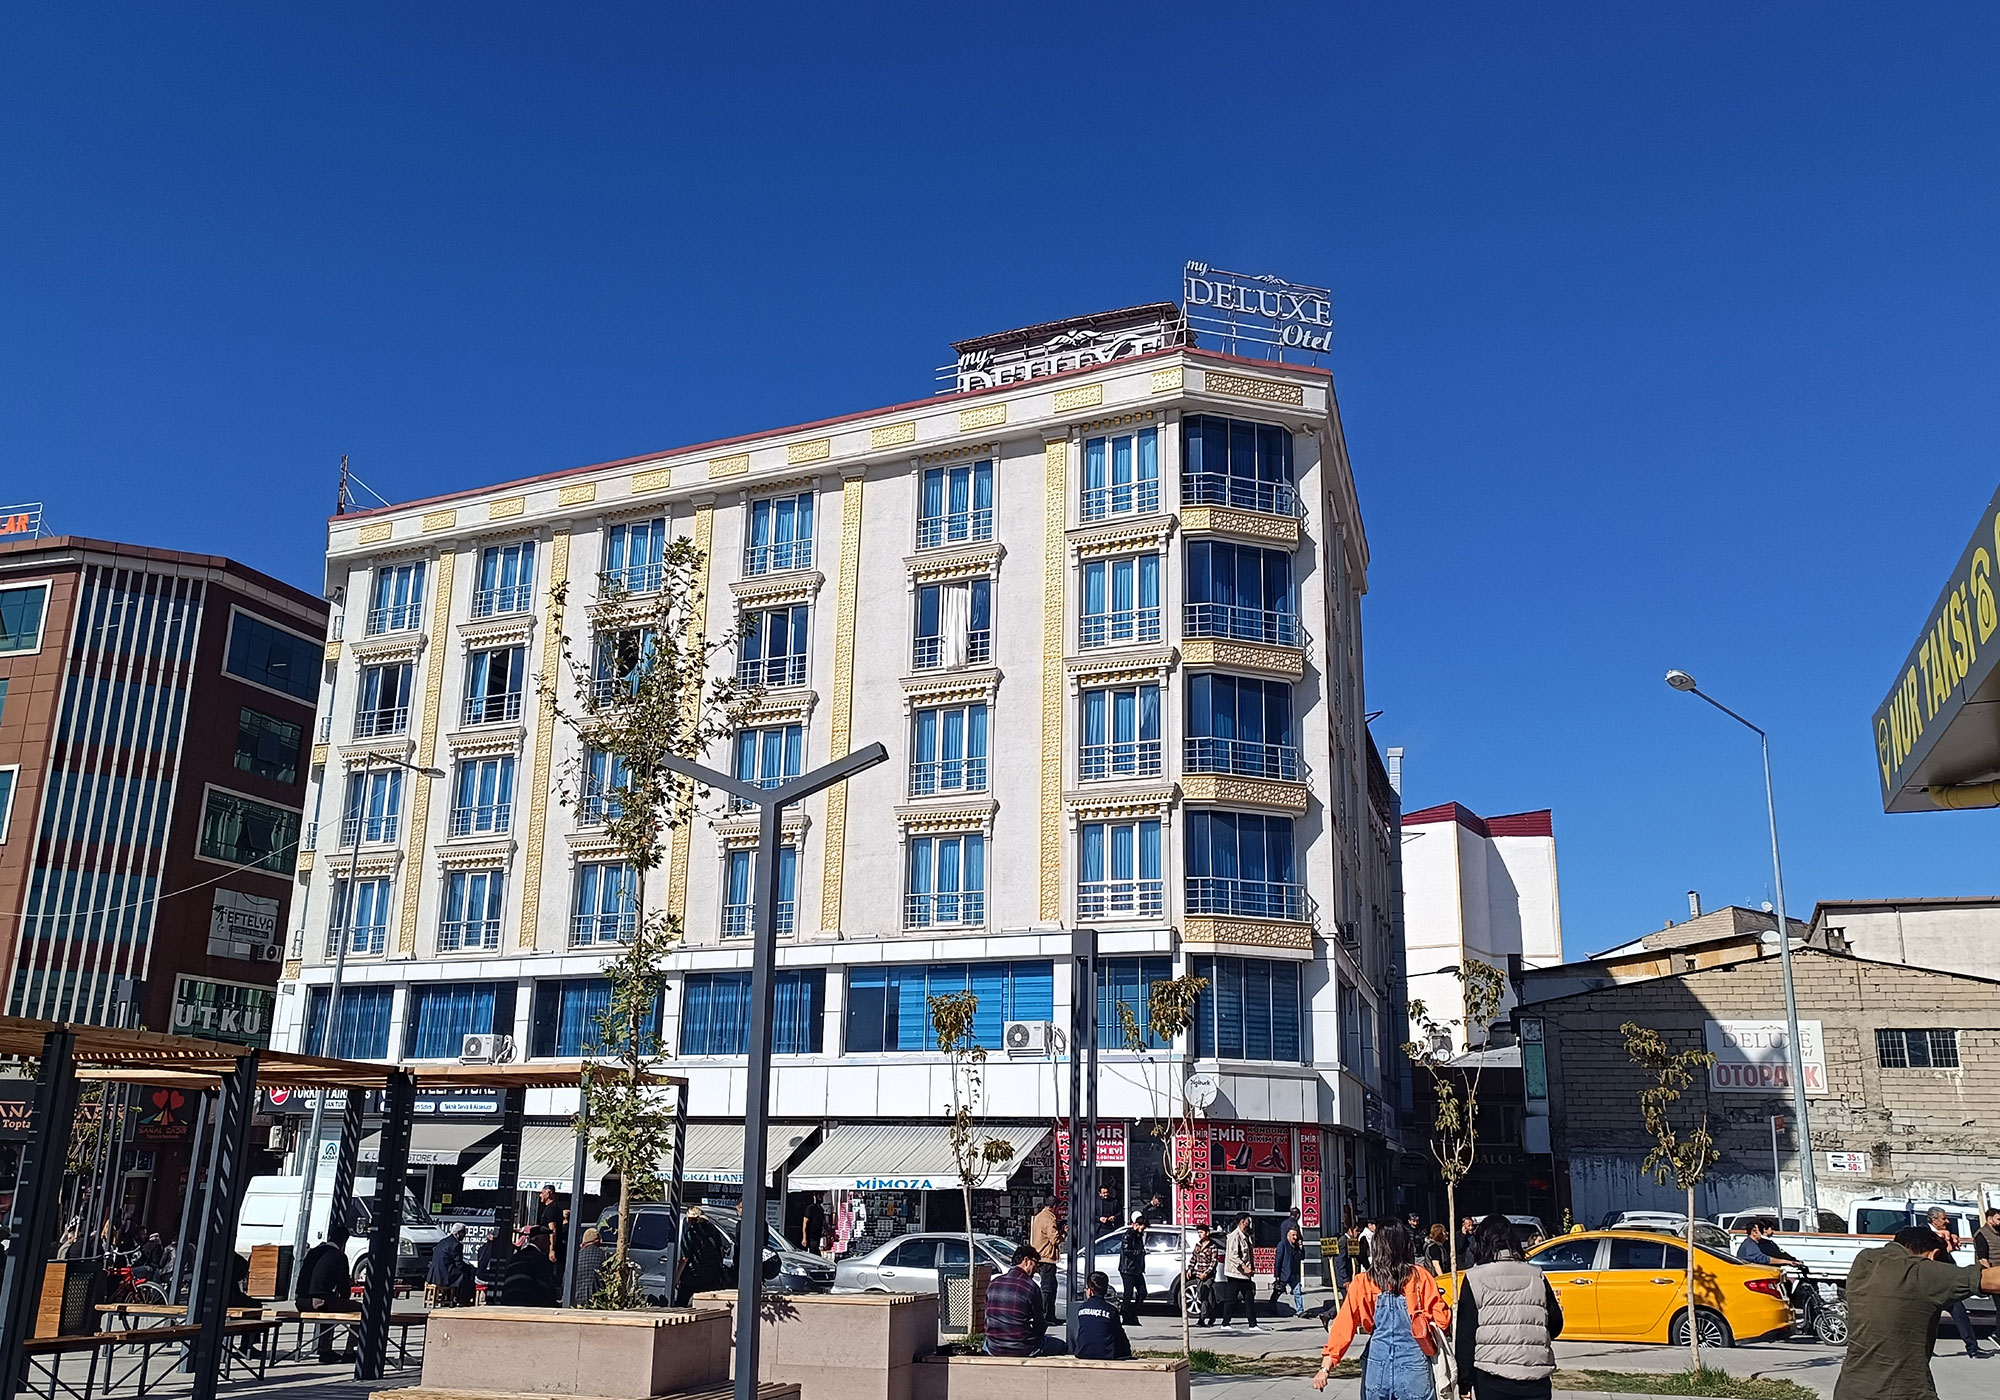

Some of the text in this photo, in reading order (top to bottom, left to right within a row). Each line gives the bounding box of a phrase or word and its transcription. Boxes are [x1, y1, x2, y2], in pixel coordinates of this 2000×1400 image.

[1187, 260, 1208, 276] my
[1186, 277, 1333, 327] DELUXE
[1283, 324, 1333, 351] Otel
[960, 349, 990, 370] my
[1889, 581, 1976, 773] NUR TAKSİ
[175, 1003, 261, 1034] UTKU
[1720, 1024, 1733, 1033] my
[1716, 1064, 1820, 1087] OTOPAK
[1210, 1125, 1246, 1142] EMİR
[1302, 1144, 1317, 1215] KUNDURA
